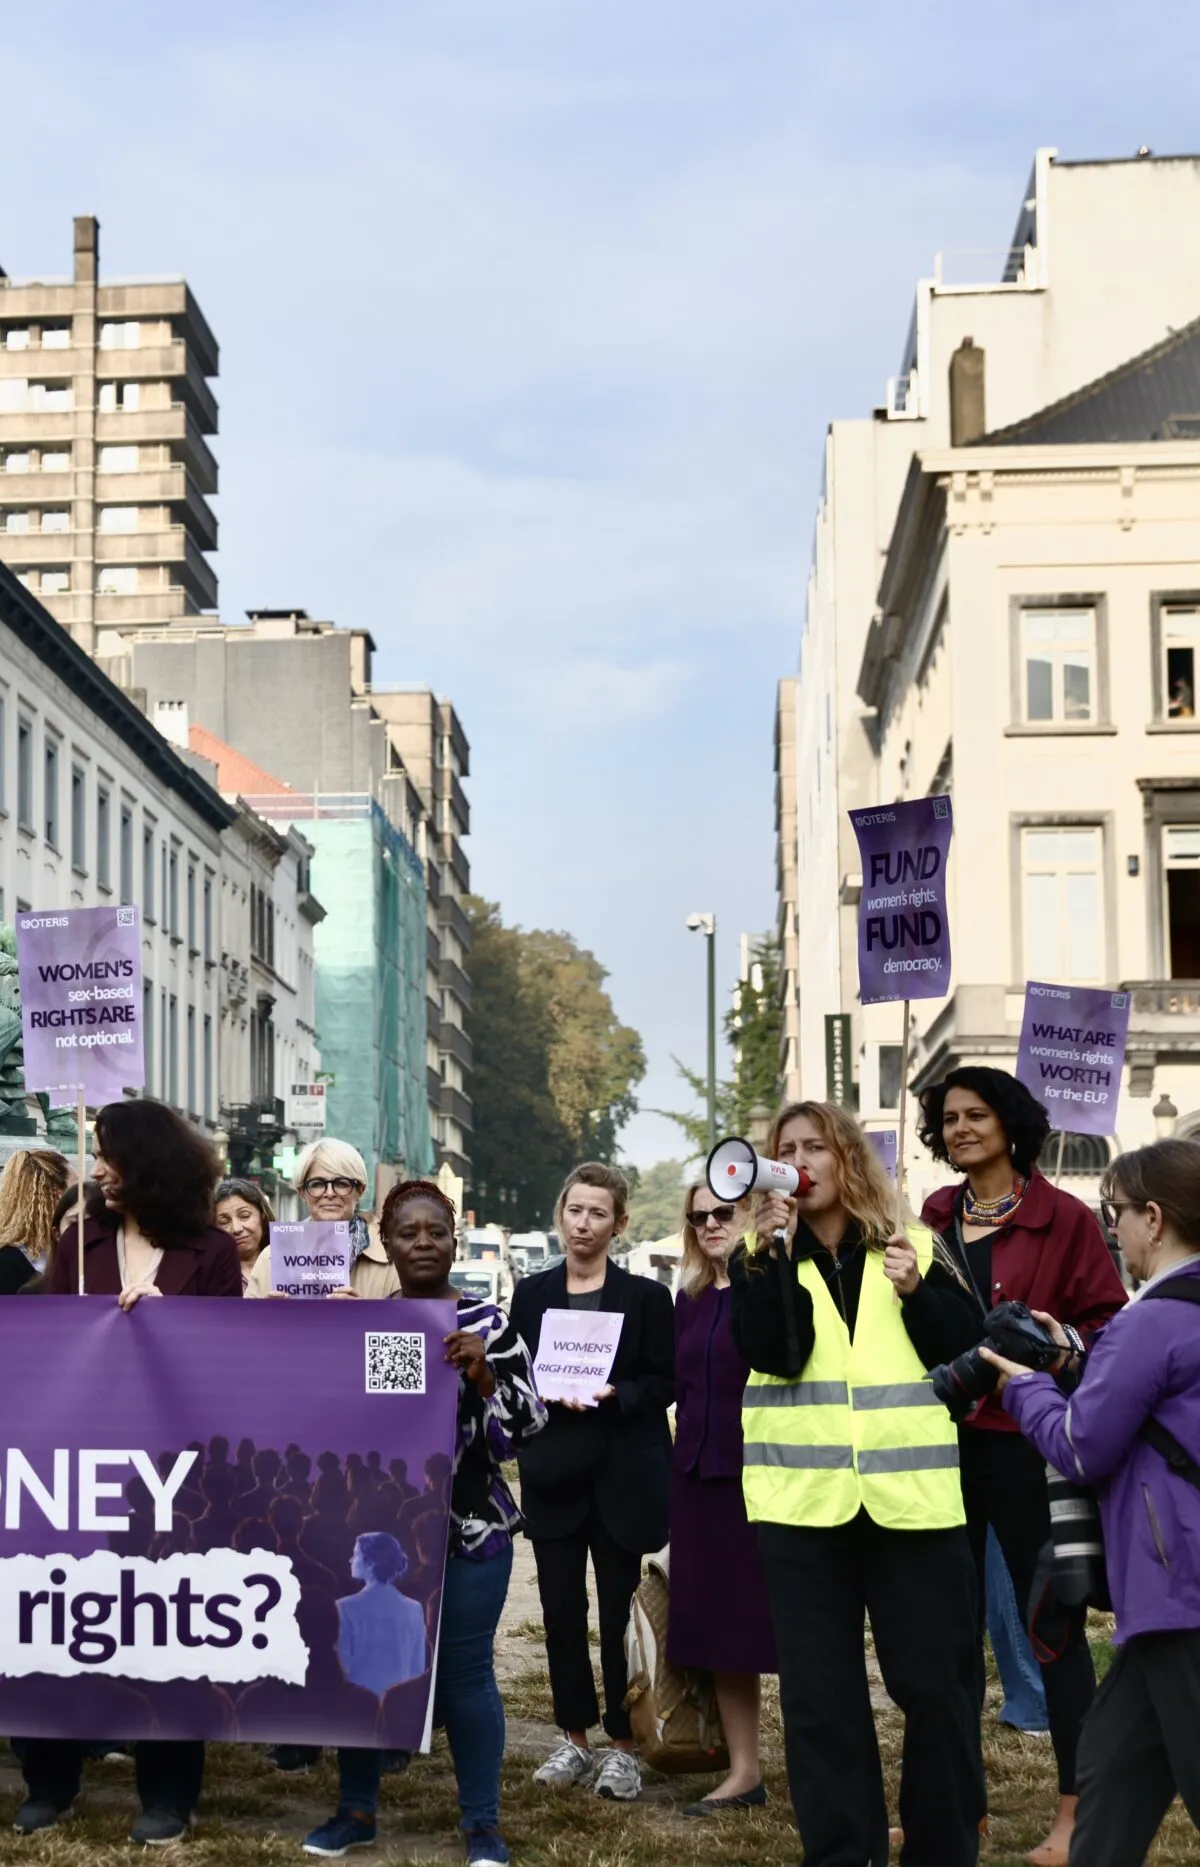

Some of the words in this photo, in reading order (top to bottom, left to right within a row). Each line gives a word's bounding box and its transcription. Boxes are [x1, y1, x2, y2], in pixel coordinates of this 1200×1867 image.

[870, 846, 941, 888] FUND
[867, 891, 907, 910] women's
[909, 888, 938, 907] rights.
[866, 911, 941, 952] FUND
[38, 960, 134, 983] WOMEN'S
[883, 957, 943, 973] democracy.
[68, 984, 134, 1002] sex-based
[30, 1007, 96, 1029] RIGHTS
[98, 1005, 135, 1025] ARE
[55, 1034, 78, 1048] not
[79, 1029, 135, 1049] optional.
[1031, 1023, 1084, 1043] WHAT
[1083, 1031, 1117, 1047] ARE
[1029, 1045, 1080, 1061] women's
[1081, 1050, 1114, 1065] rights
[1039, 1062, 1111, 1087] WORTH
[1044, 1085, 1062, 1098] for
[1063, 1087, 1083, 1101] the
[1084, 1090, 1109, 1105] EU?
[283, 1255, 345, 1267] WOMEN'S
[553, 1340, 613, 1354] WOMEN'S
[537, 1363, 580, 1374] RIGHTS
[580, 1366, 606, 1377] ARE
[18, 1568, 282, 1664] rights?
